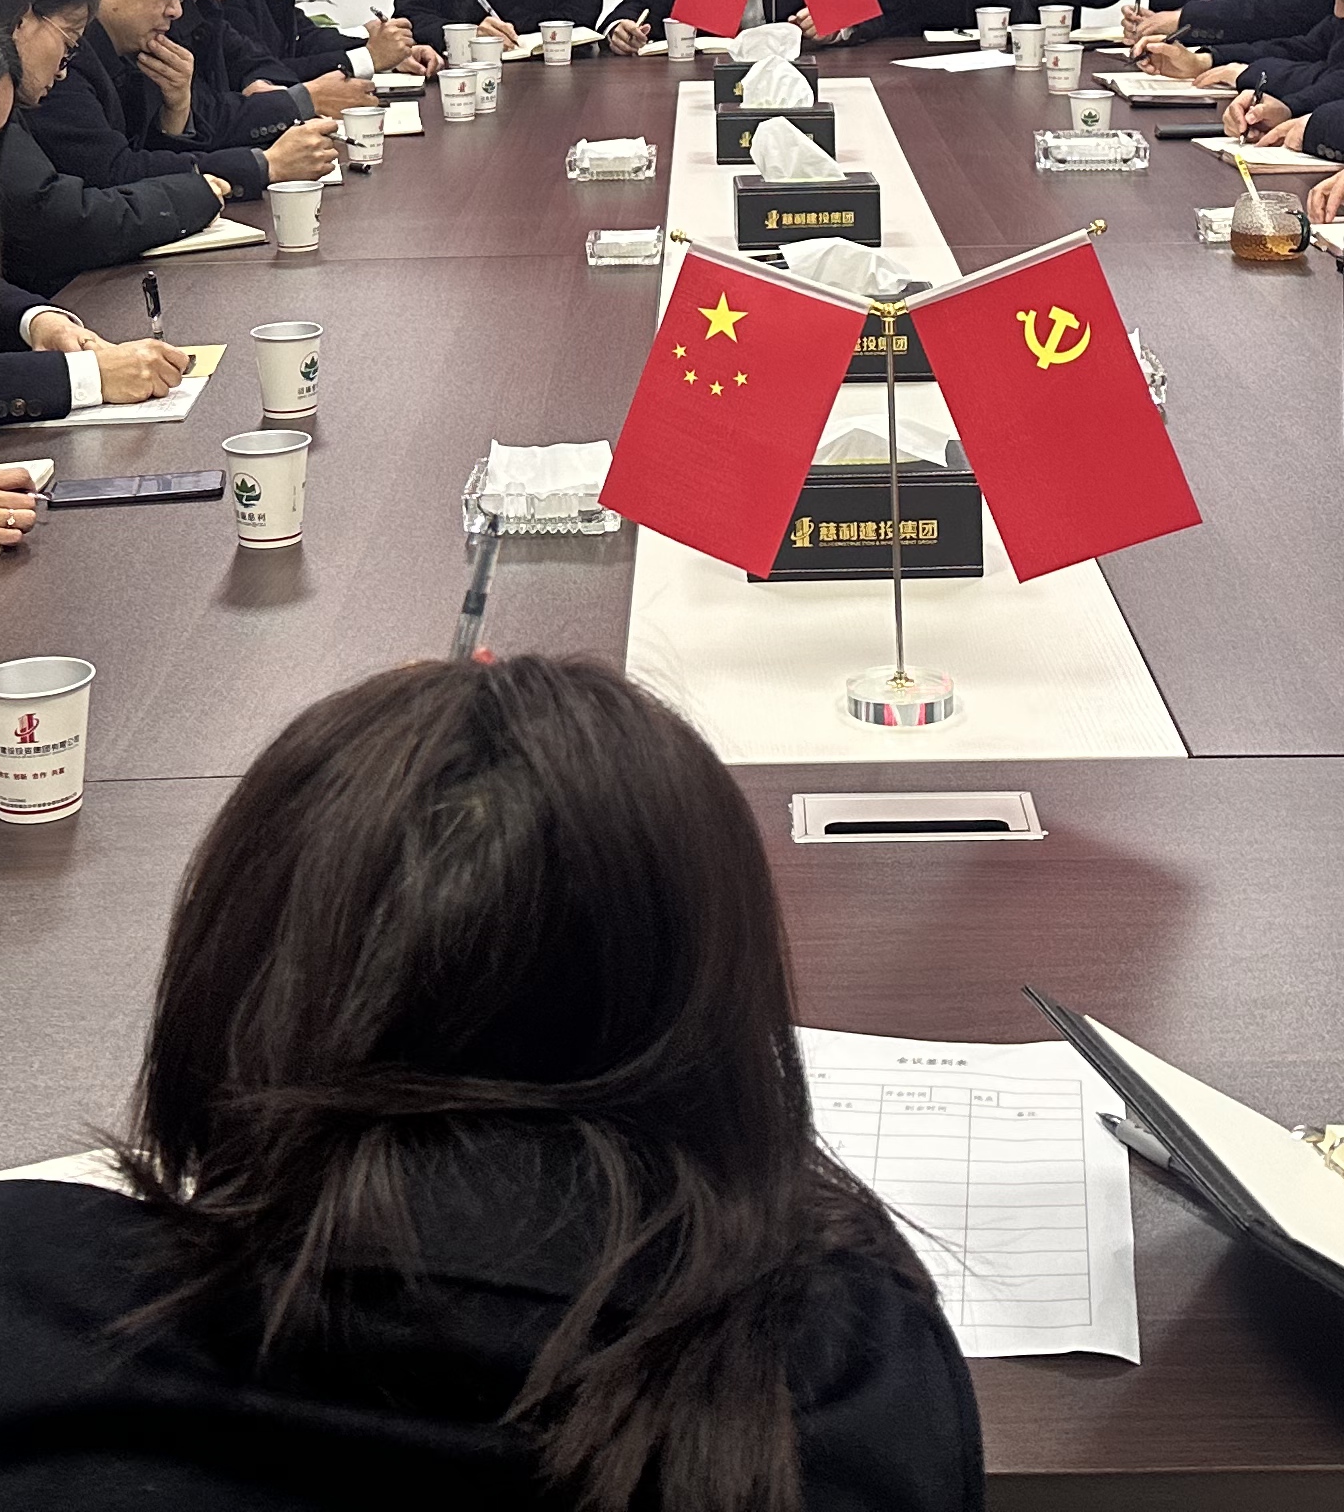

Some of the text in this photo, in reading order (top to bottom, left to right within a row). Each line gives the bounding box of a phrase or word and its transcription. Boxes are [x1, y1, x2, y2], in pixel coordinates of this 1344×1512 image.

[818, 520, 938, 541] 慈利建投集团
